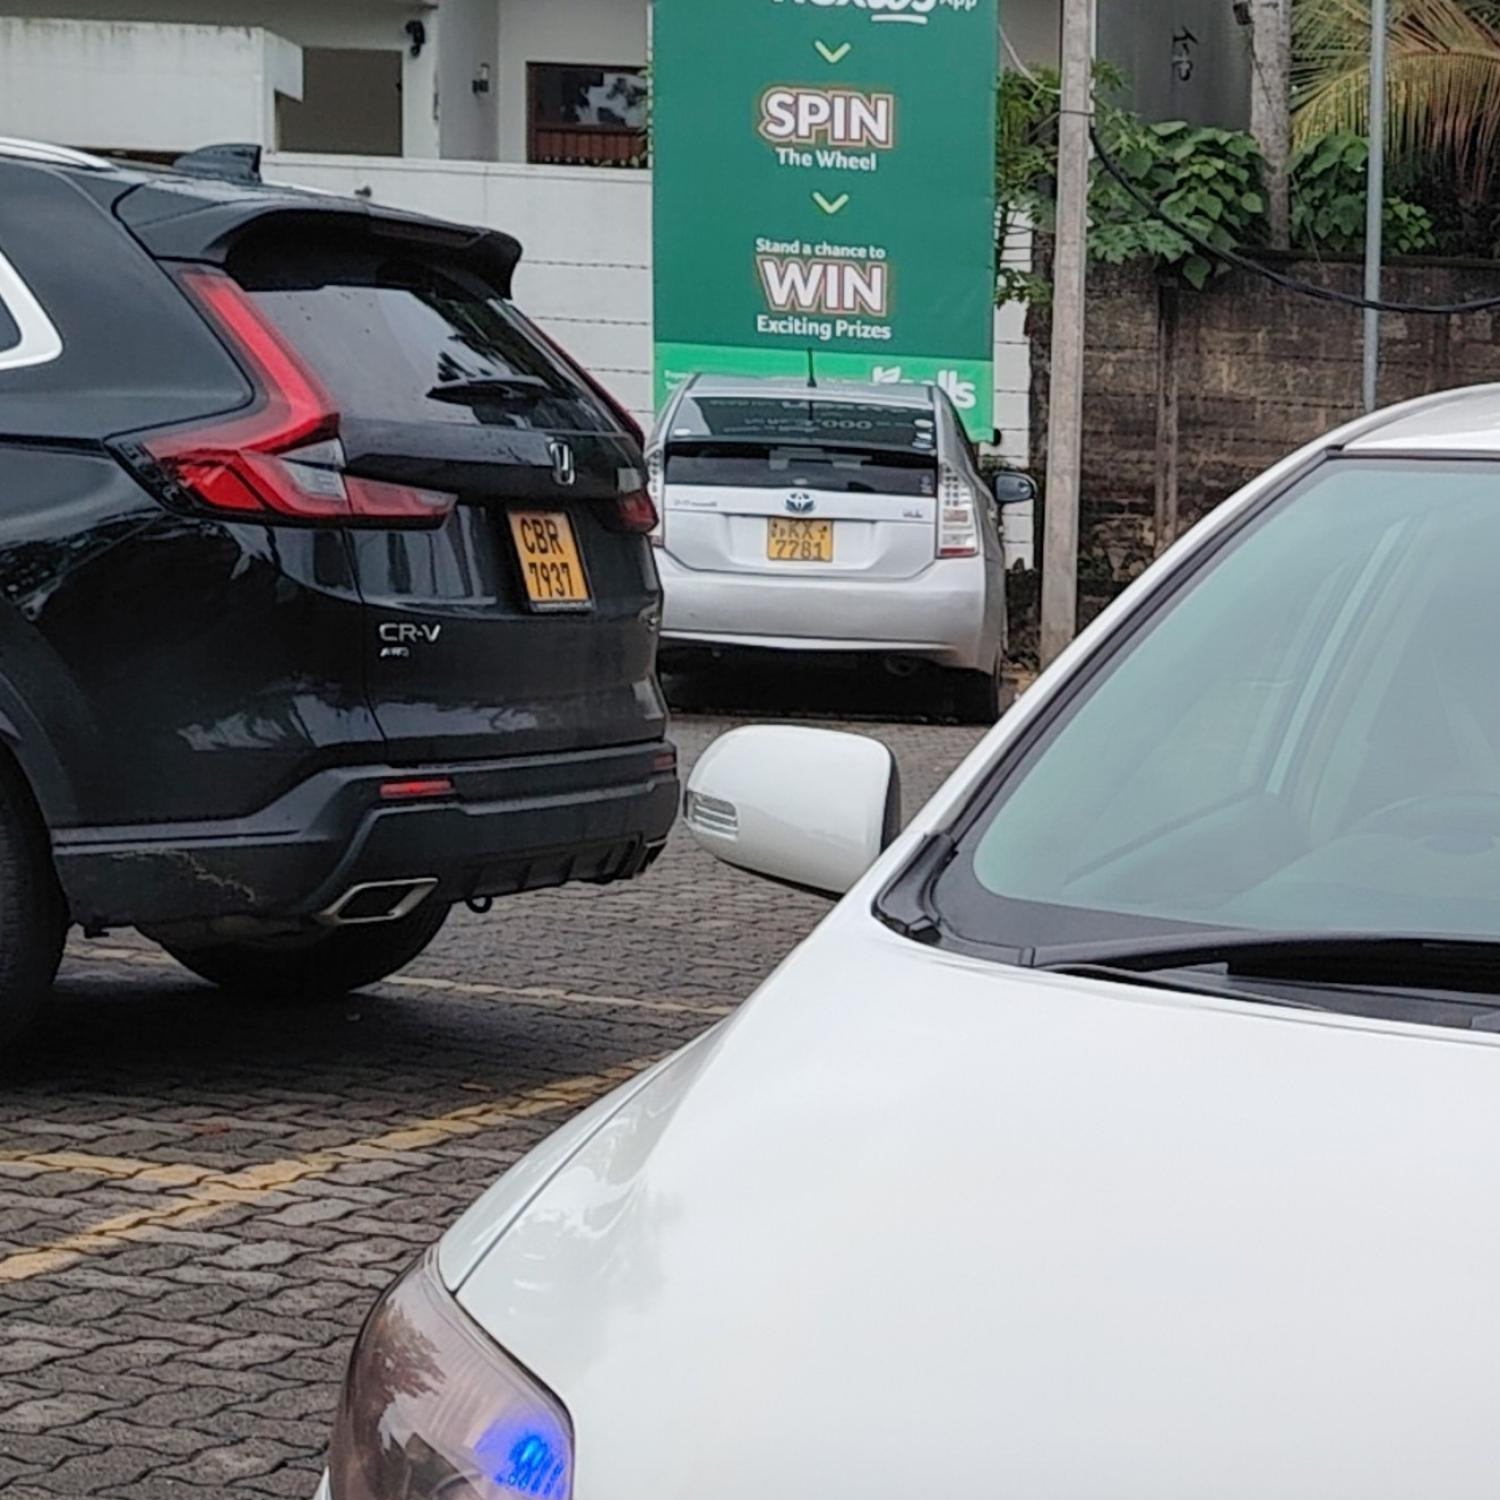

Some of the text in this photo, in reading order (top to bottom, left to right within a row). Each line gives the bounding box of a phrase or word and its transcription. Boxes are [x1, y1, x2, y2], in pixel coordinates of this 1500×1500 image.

[764, 91, 889, 144] SPIN
[775, 147, 877, 171] The Wheel
[756, 237, 886, 259] Stand a chance to
[760, 259, 884, 312] WIN
[757, 315, 891, 340] Exciting Prizes
[520, 518, 564, 554] CBR
[775, 540, 822, 559] 7781
[528, 562, 574, 597] 7937
[379, 623, 441, 642] CR-V
